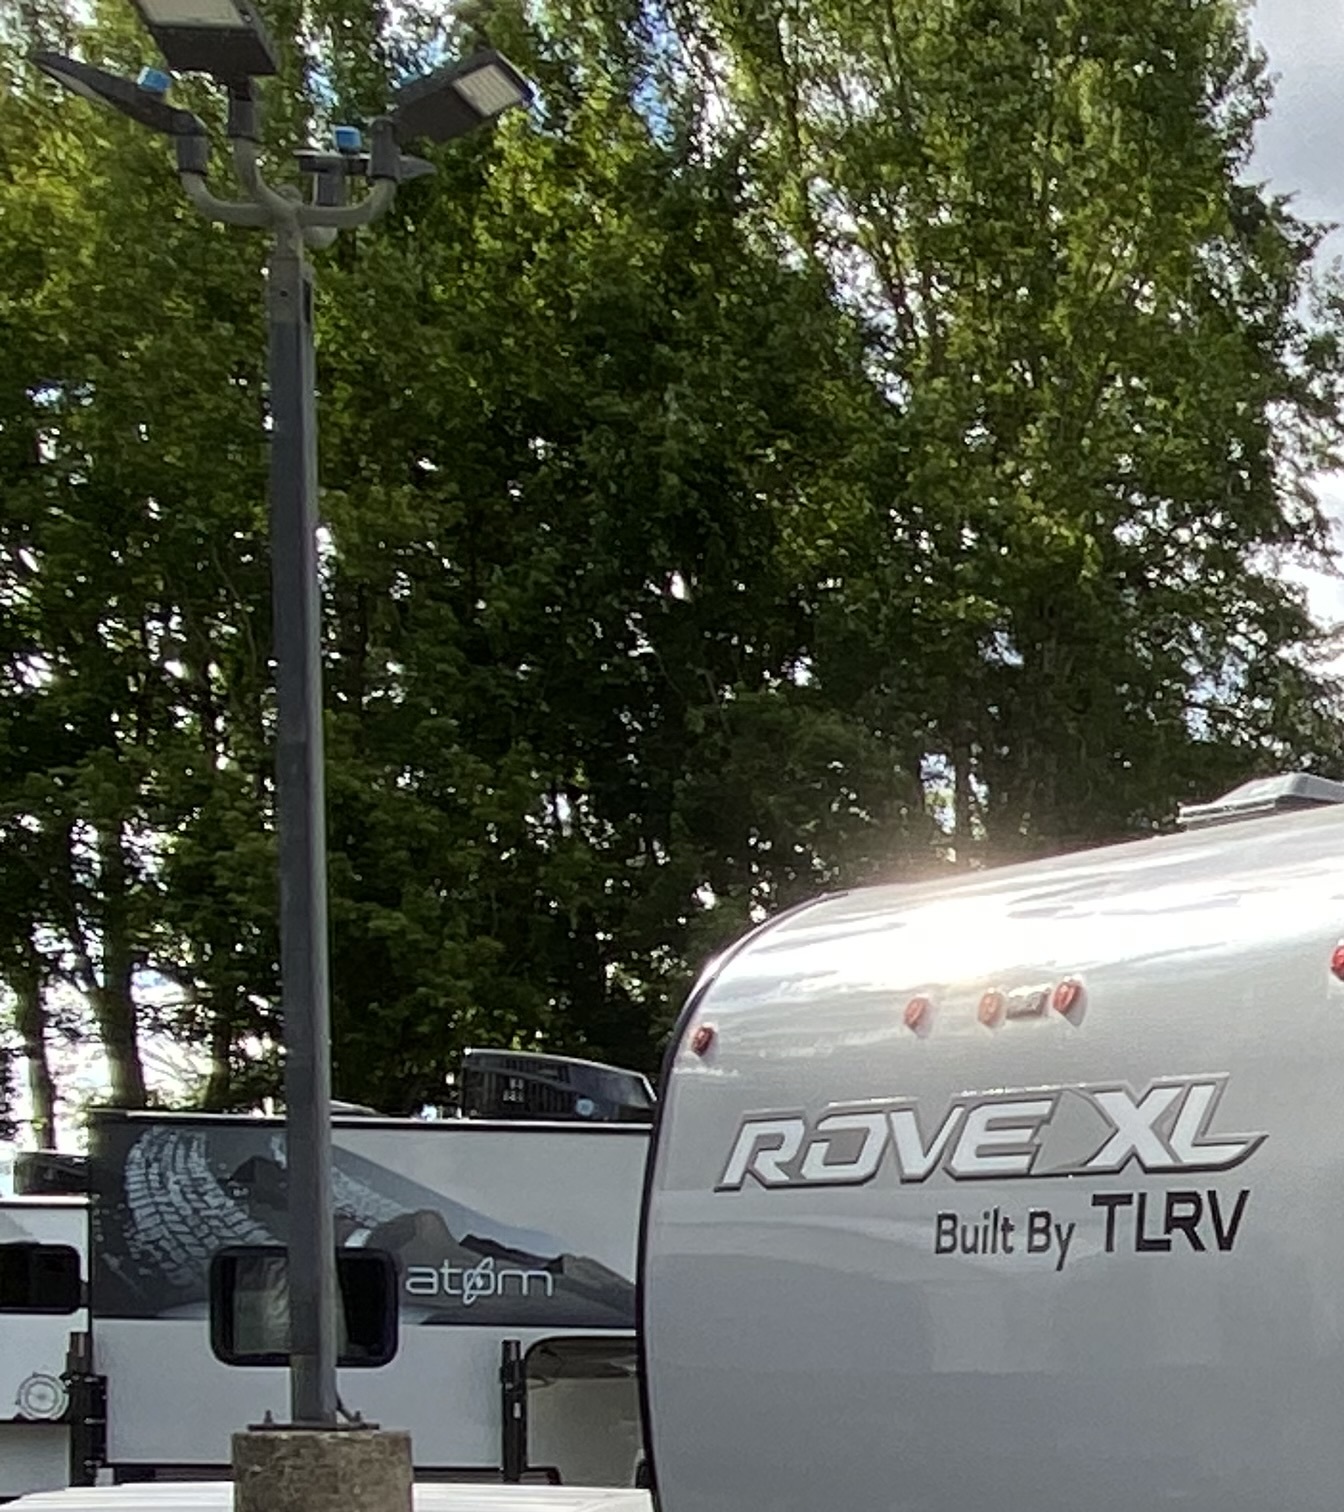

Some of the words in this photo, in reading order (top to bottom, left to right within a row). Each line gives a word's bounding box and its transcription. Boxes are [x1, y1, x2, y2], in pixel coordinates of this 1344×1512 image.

[713, 1090, 1060, 1192] ROVE
[1084, 1073, 1270, 1174] XL
[934, 1207, 1015, 1255] Built
[1027, 1207, 1076, 1271] By
[1091, 1189, 1251, 1253] TLRV
